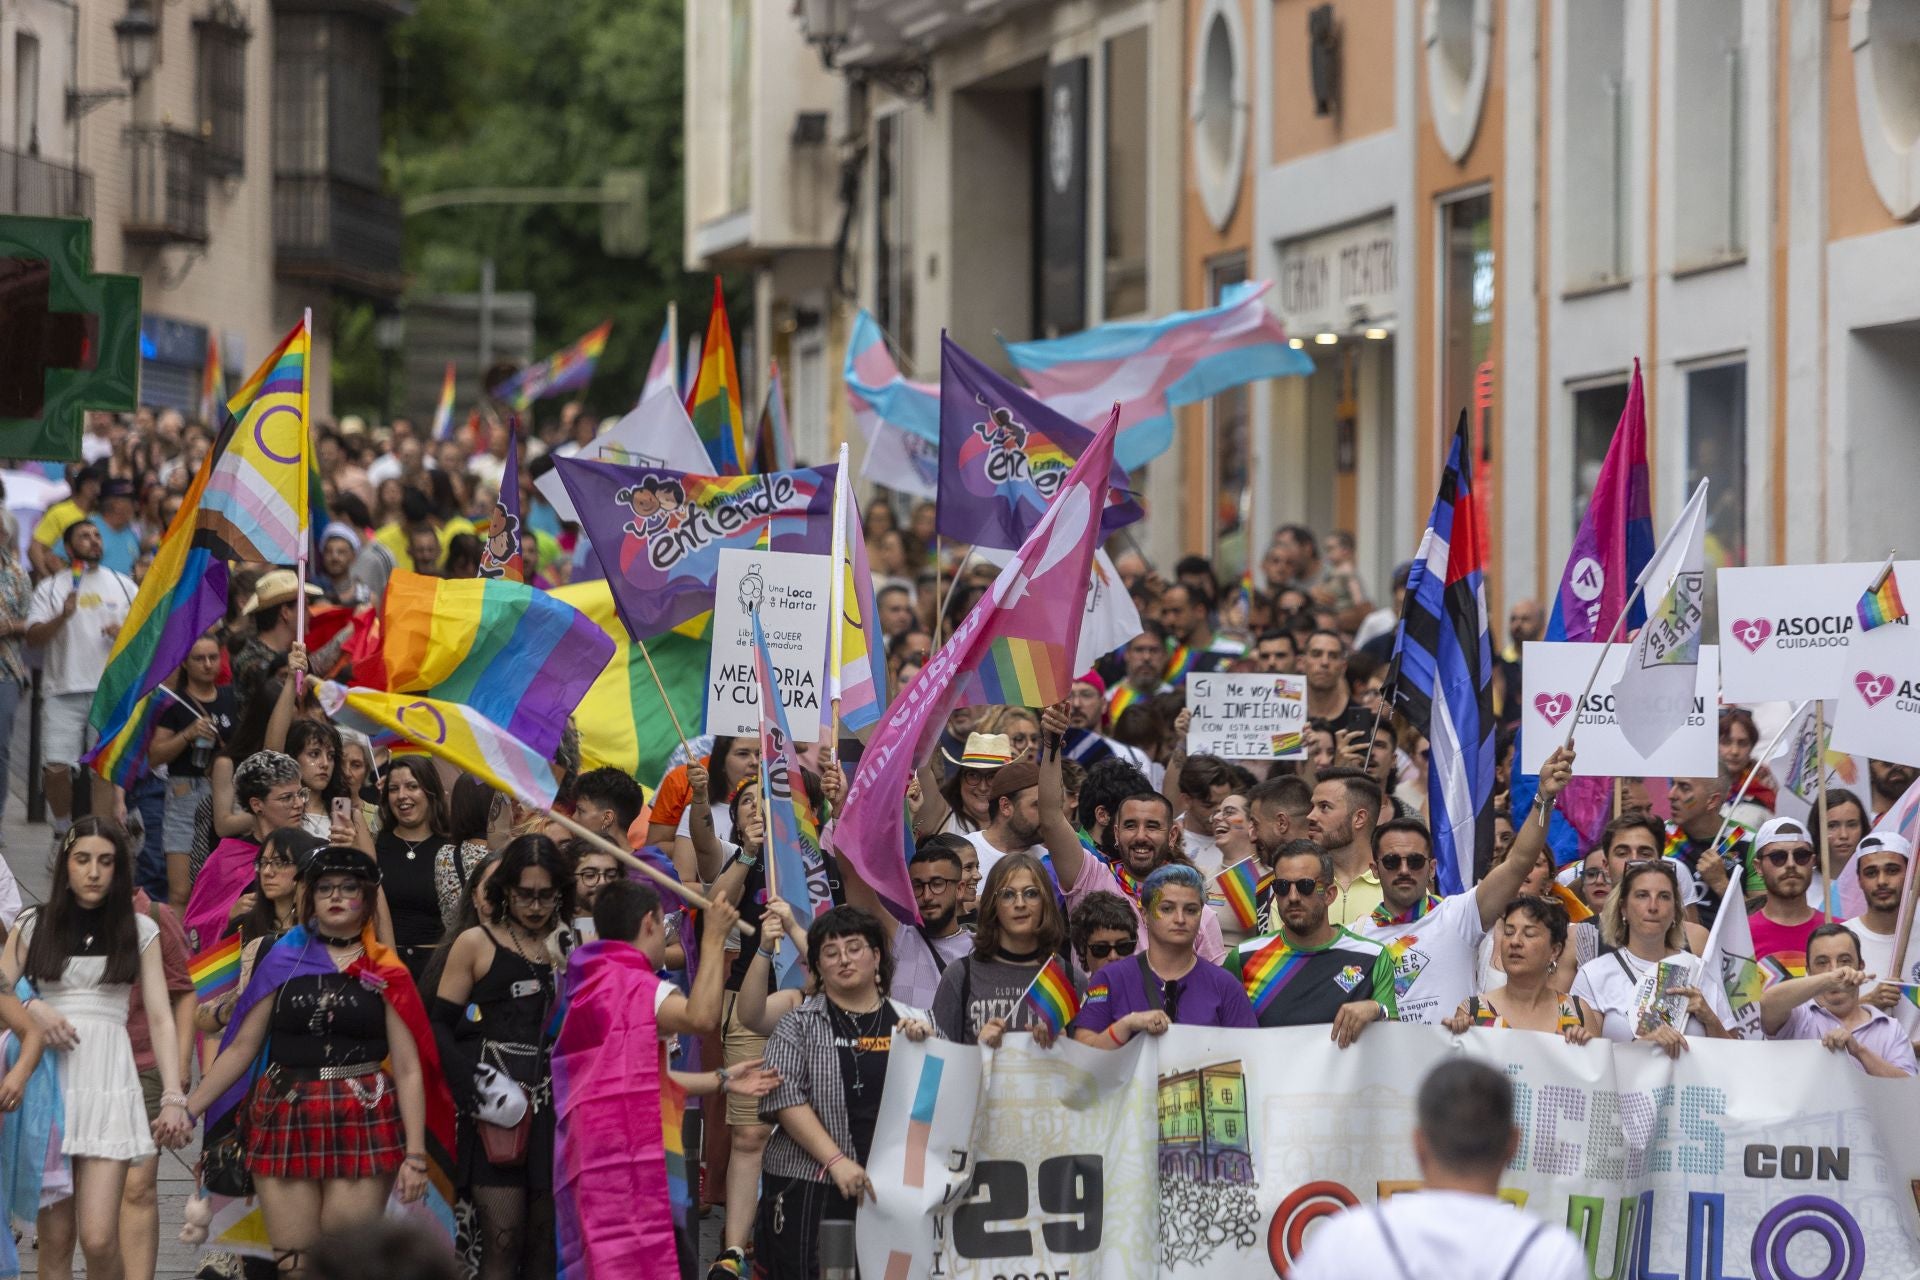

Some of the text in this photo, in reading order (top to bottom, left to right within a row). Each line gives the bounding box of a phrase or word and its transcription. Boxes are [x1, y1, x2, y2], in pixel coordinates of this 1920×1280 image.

[652, 473, 794, 569] entiende
[768, 584, 813, 598] Una Loca
[780, 597, 817, 610] Hartar
[773, 631, 802, 641] QUEER
[1776, 636, 1850, 649] CUIDADOQ
[736, 637, 803, 651] de Eemadura
[714, 683, 819, 709] Y CUURA
[1192, 702, 1302, 719] AL INFIERNO
[1201, 722, 1224, 733] CON
[1212, 741, 1271, 756] FELIZ
[1743, 1143, 1851, 1182] CON
[952, 1153, 1105, 1260] 29
